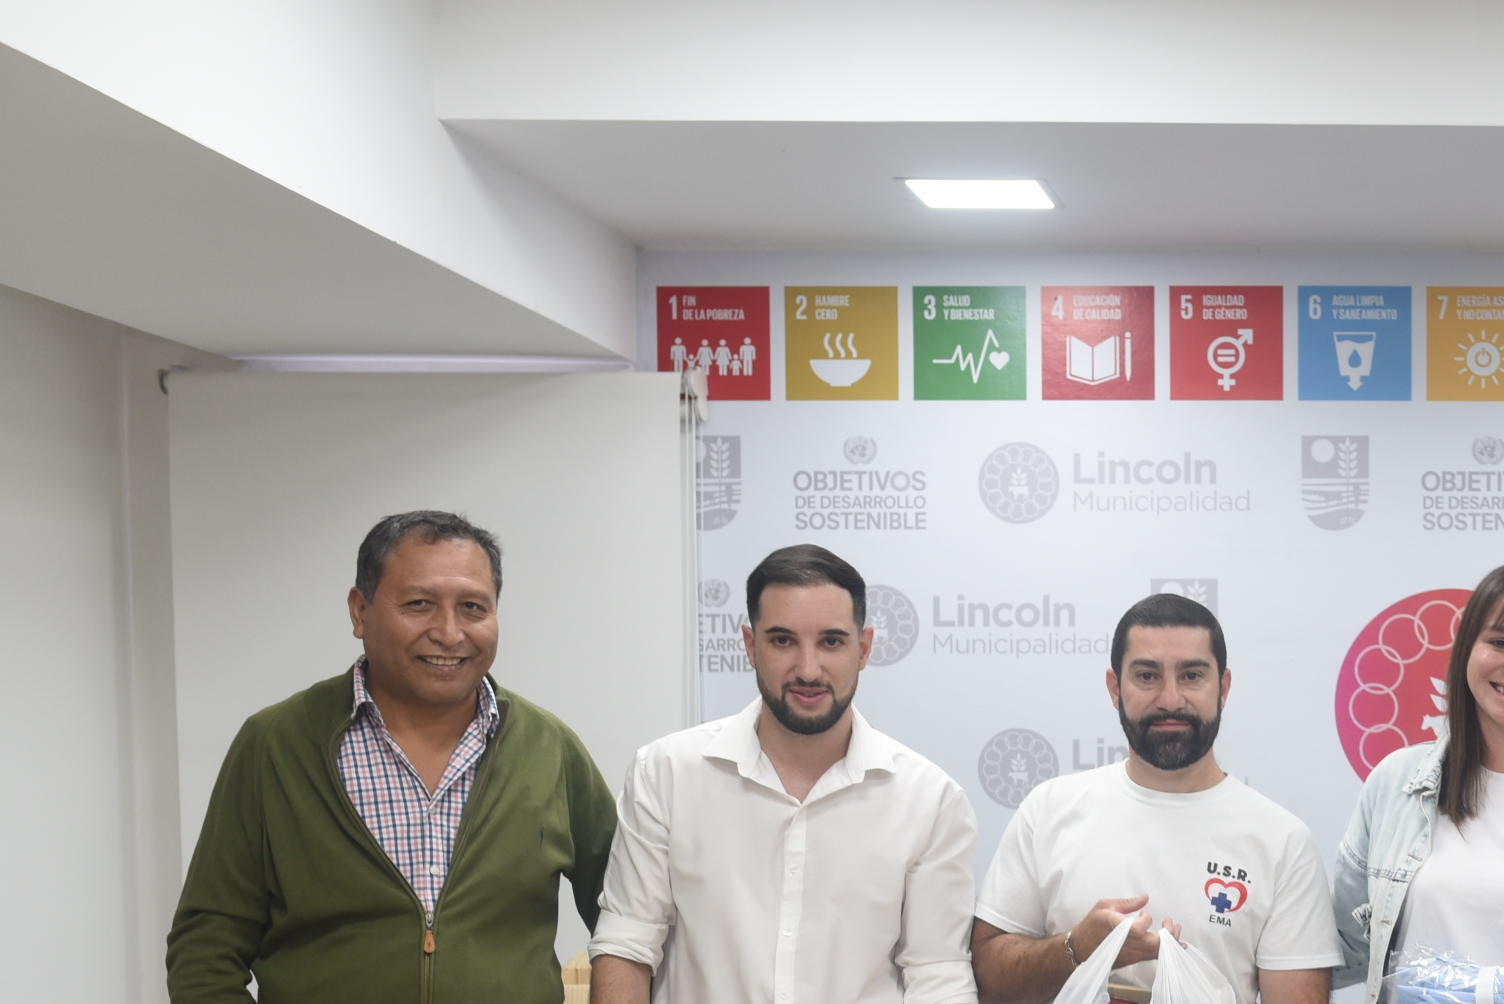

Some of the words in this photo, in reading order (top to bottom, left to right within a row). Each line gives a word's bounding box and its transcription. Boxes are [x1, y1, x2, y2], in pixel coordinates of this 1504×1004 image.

[669, 295, 678, 320] 1
[683, 295, 696, 306] FIN
[796, 295, 807, 320] 2
[815, 295, 849, 306] HAMBRE
[923, 295, 936, 320] 3
[943, 295, 970, 306] SALUD
[1051, 295, 1064, 320] 4
[1180, 295, 1193, 320] 5
[1202, 295, 1244, 306] IGUALDAD
[1308, 295, 1322, 320] 6
[1332, 295, 1355, 306] AGUA
[1357, 295, 1384, 306] LIMPIA
[1437, 296, 1448, 320] 7
[683, 309, 693, 320] DE
[695, 309, 705, 320] LA
[706, 309, 745, 320] POBREZA
[815, 309, 838, 320] CERO
[943, 309, 949, 320] Y
[950, 309, 995, 320] BIENESTAR
[1073, 309, 1084, 320] DE
[1085, 309, 1121, 320] CALIDAD
[1202, 309, 1214, 320] DE
[1215, 307, 1248, 320] GÉNERO
[1332, 309, 1338, 320] Y
[1339, 309, 1397, 320] SANEAMIENTO
[1073, 452, 1217, 485] Lincoln
[793, 471, 926, 492] OBJETIVOS
[795, 496, 818, 509] DE
[822, 496, 926, 509] DESARROLLO
[1073, 490, 1251, 516] Municipalidad
[1423, 496, 1446, 510] DE
[795, 512, 926, 530] SOSTENIBLE
[933, 594, 1075, 628] Lincoln
[933, 633, 1111, 659] Municipalidad
[1207, 861, 1251, 884] U.S.R.
[1209, 914, 1232, 928] EMA
